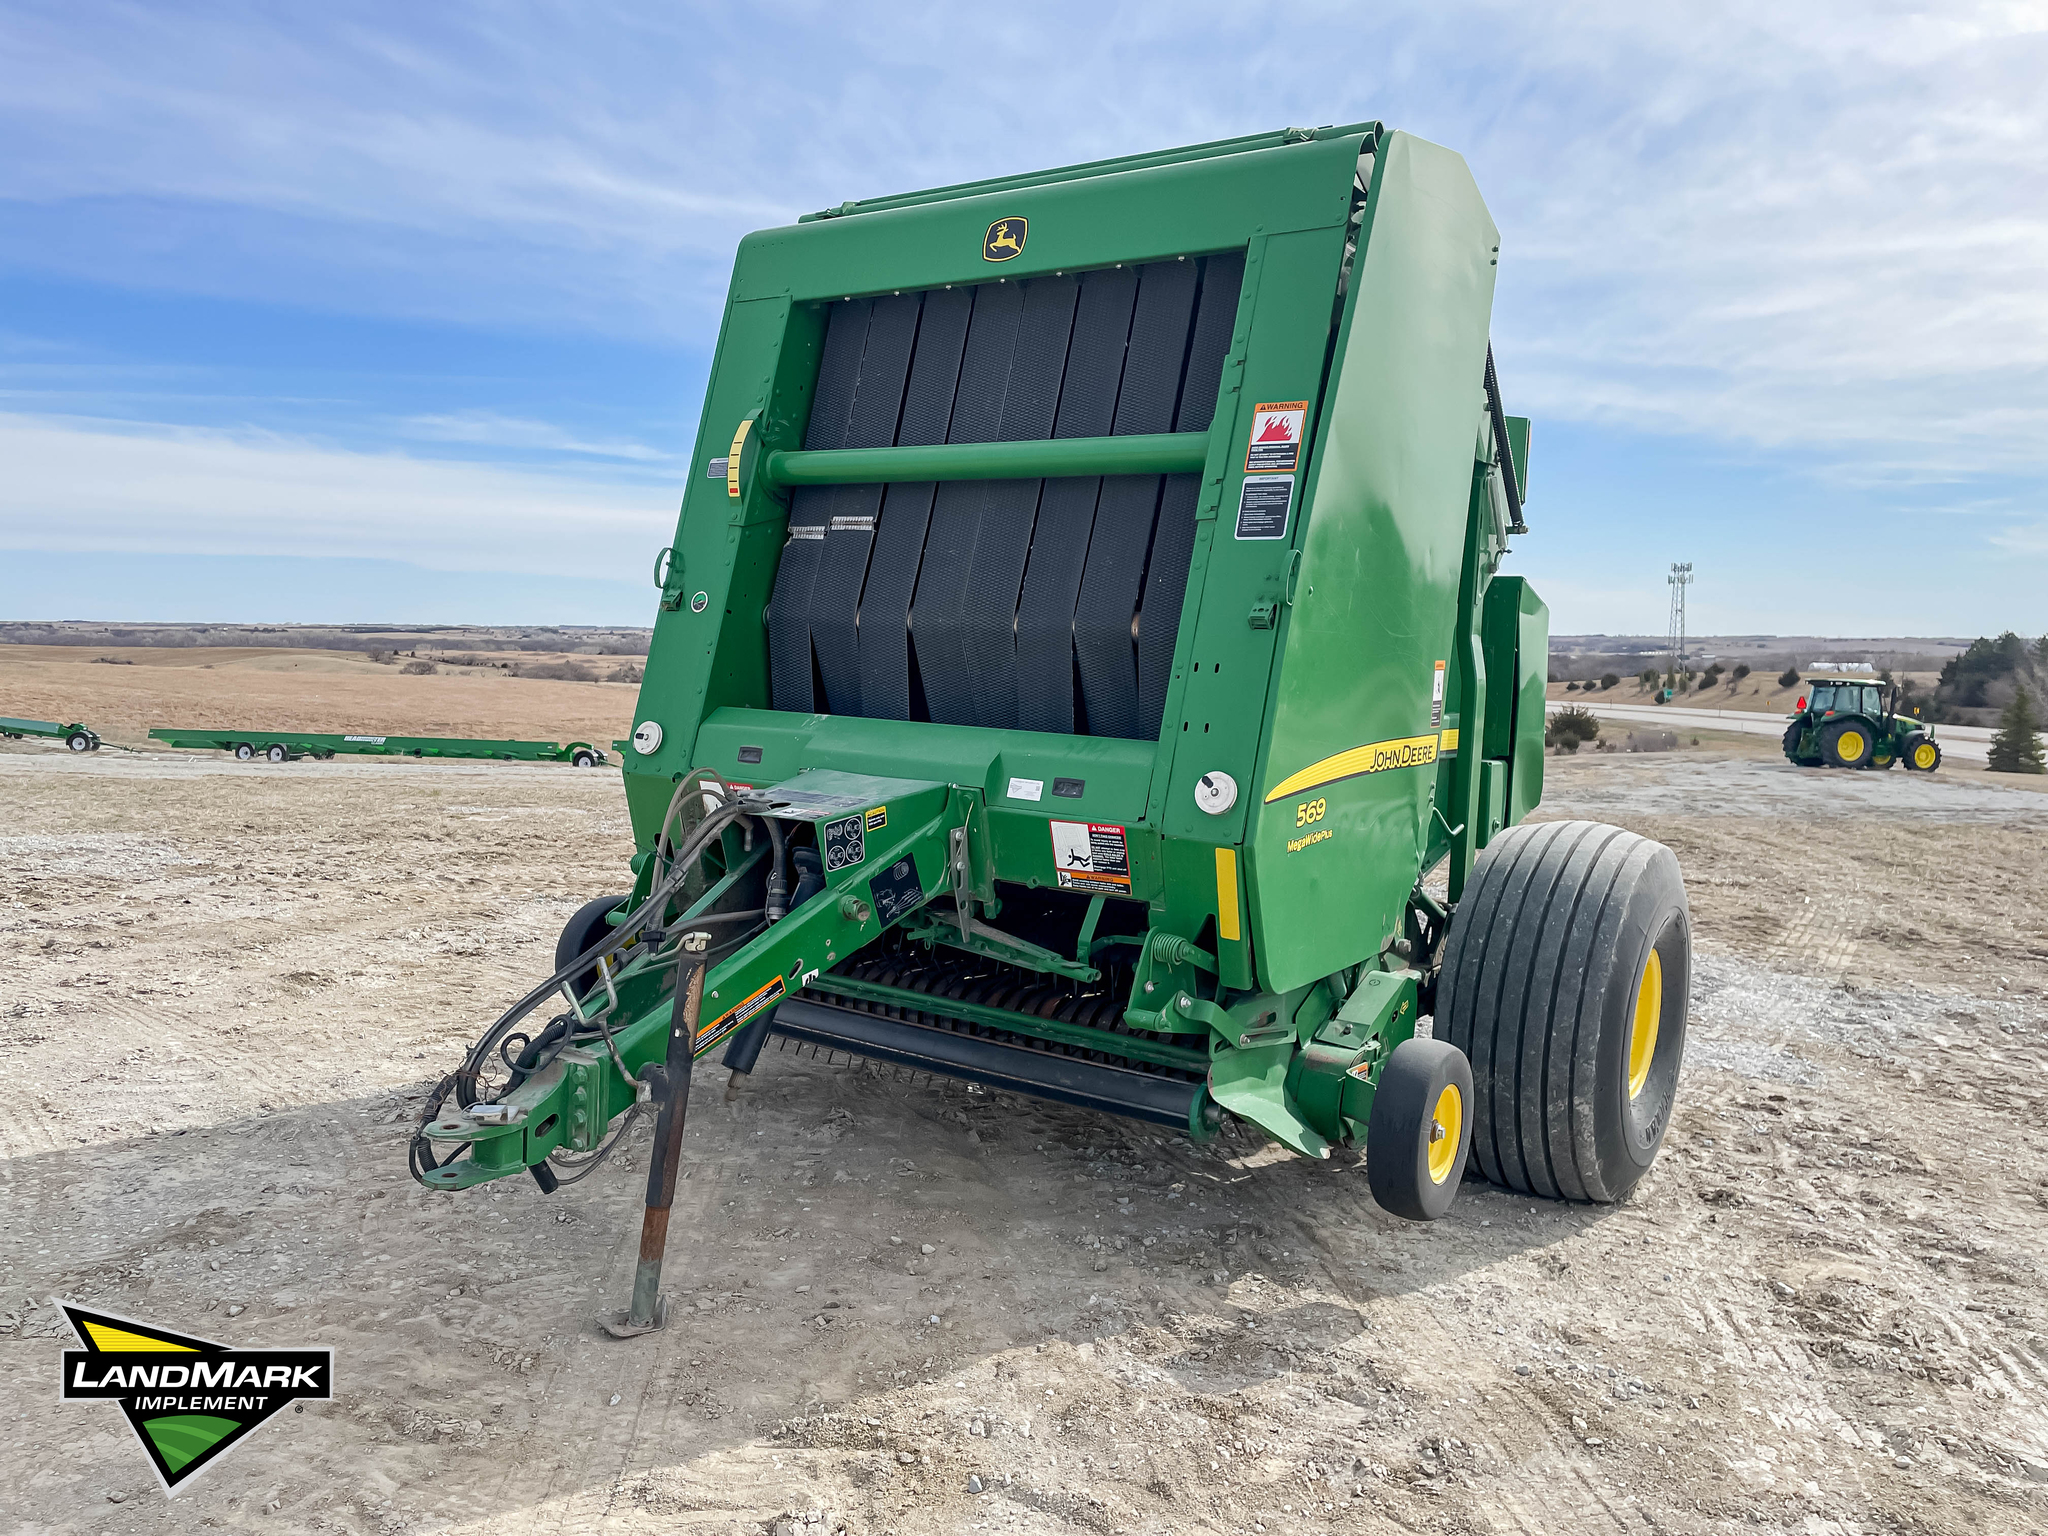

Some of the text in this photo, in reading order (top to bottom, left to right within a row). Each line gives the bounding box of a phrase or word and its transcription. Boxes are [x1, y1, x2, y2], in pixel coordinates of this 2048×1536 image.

[1266, 402, 1303, 410] WARNING
[1370, 744, 1433, 770] JOHN DEERE
[1296, 797, 1327, 828] 569
[1097, 825, 1121, 833] DANGER
[1287, 829, 1333, 853] MegaWidePlus
